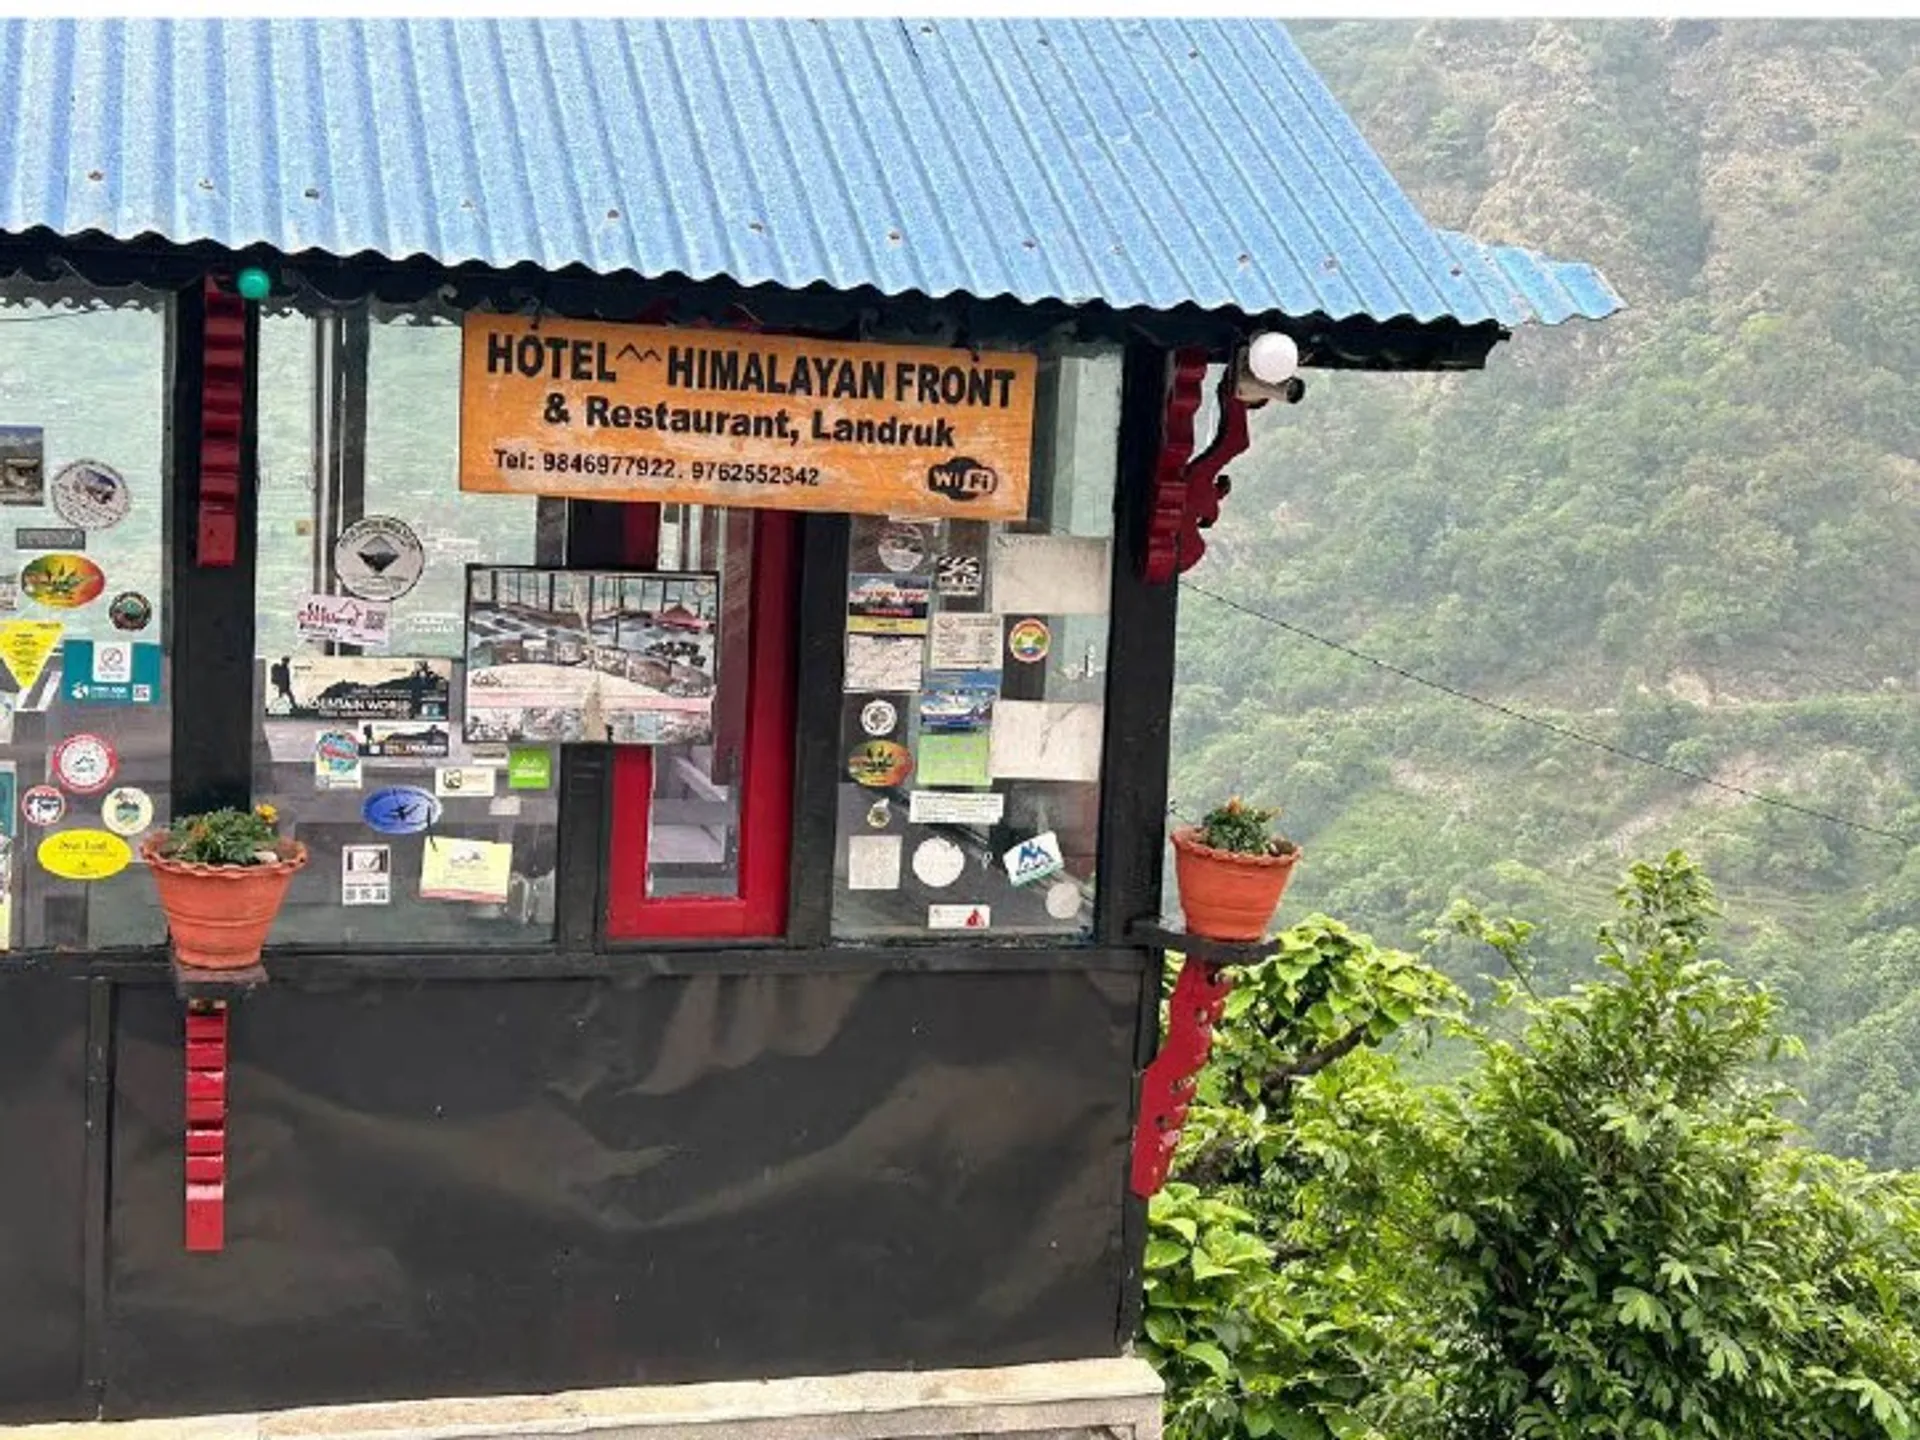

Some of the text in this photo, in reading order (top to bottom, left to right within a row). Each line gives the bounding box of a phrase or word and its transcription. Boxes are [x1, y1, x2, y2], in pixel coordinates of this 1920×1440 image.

[487, 332, 1016, 407] HOTEL HIMALAYAN FRONT
[543, 392, 955, 448] & Restaurant, Landruk
[494, 449, 535, 471] Tel:
[691, 461, 820, 487] 9762552342
